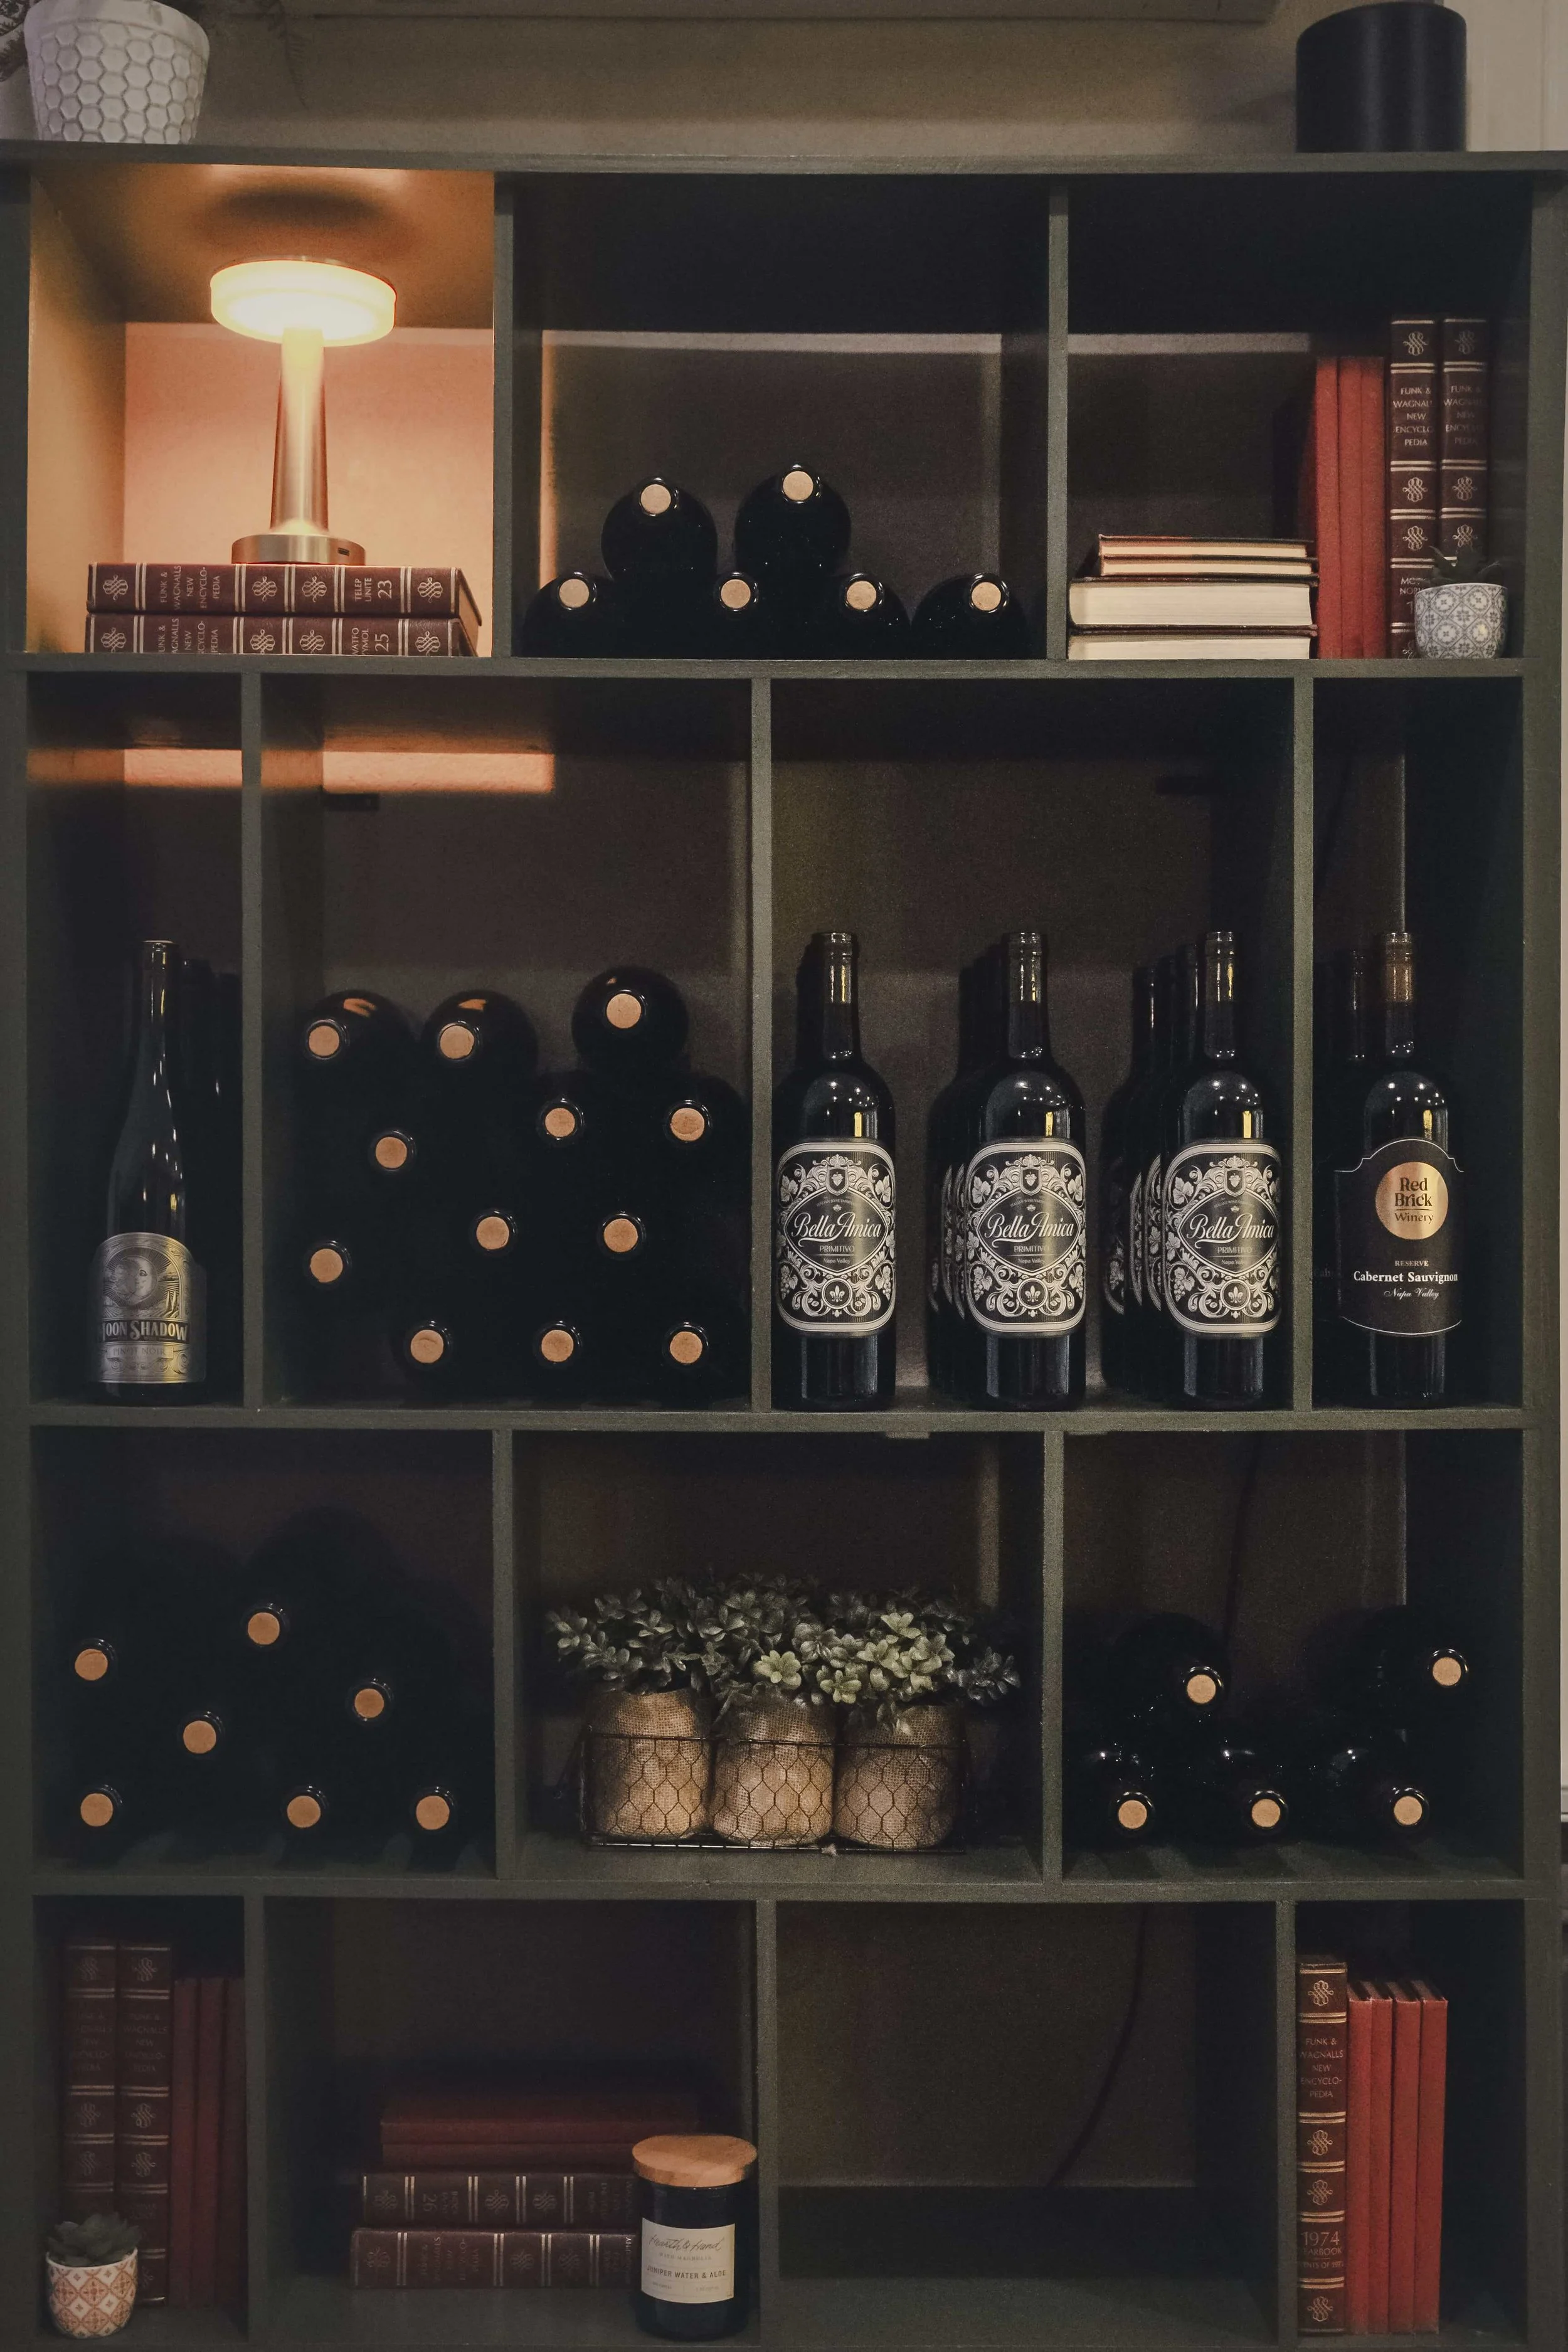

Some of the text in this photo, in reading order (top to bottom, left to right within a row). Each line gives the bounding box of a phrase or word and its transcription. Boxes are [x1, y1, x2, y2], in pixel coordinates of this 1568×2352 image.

[1400, 386, 1422, 395] FUNK
[1406, 413, 1426, 421] NEW
[1404, 438, 1428, 447] PEDIA
[173, 565, 181, 610] WAGNALLS
[377, 580, 392, 600] 23
[157, 633, 166, 653] UNK
[171, 618, 179, 654] AGNALLS
[211, 629, 219, 653] PEDIA
[374, 633, 389, 653] 25
[1400, 1177, 1428, 1192] Red
[1394, 1192, 1433, 1207] Brick
[791, 1212, 836, 1238] Bella
[984, 1212, 1029, 1239] Bella
[1394, 1212, 1434, 1225] Winery
[1186, 1214, 1234, 1239] Bella
[1353, 1271, 1459, 1285] Cabernet Sauvignon
[1383, 1288, 1440, 1301] Napa Valley
[1305, 2037, 1338, 2046] FUNK &
[1311, 2063, 1332, 2072] NEW
[1309, 2090, 1334, 2099] PEDIA
[690, 2238, 725, 2252] Hand
[1300, 2231, 1340, 2247] 1974
[646, 2264, 672, 2277] JUNIPER
[674, 2271, 699, 2280] WATER
[709, 2269, 727, 2278] ALOE
